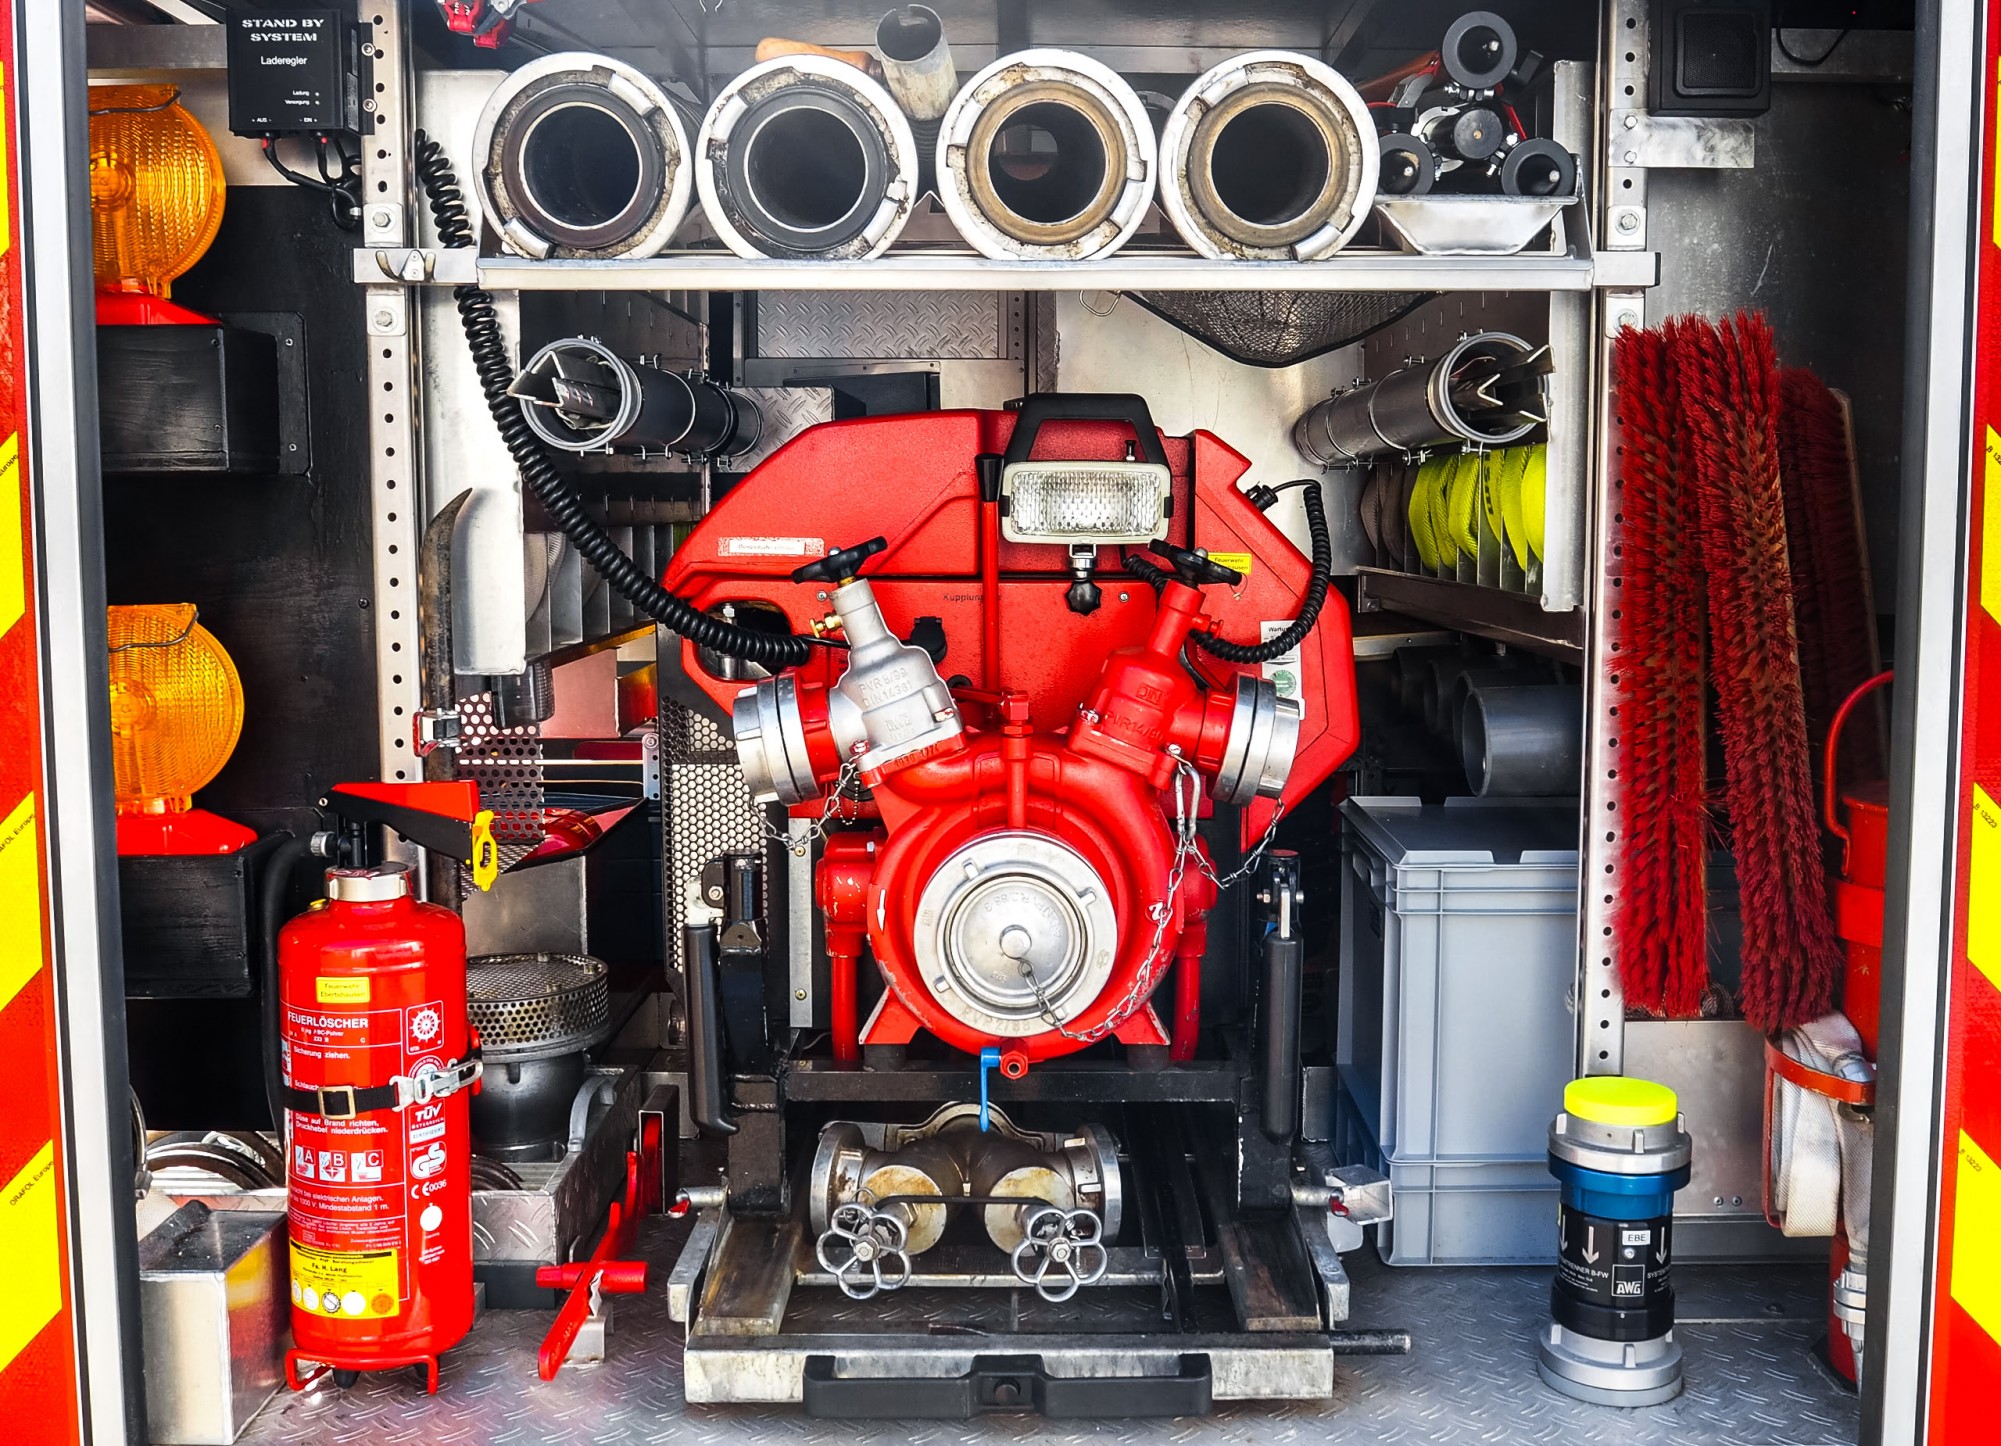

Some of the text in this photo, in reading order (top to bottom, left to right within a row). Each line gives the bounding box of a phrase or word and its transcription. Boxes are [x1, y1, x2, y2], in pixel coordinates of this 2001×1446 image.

[241, 19, 324, 28] STAND BY
[250, 33, 317, 42] SYSTEM
[260, 56, 307, 67] Laderegler
[287, 1011, 369, 1029] FEUERLÖSCHER
[325, 1052, 351, 1060] ziehen.
[415, 1103, 443, 1122] TÜV
[295, 1121, 389, 1135] Druckhebel niederdrücken.
[324, 1119, 346, 1127] Brand
[304, 1149, 314, 1163] A
[333, 1153, 344, 1167] B
[367, 1153, 379, 1166] C
[9, 1182, 35, 1206] ORAFOL
[313, 1192, 350, 1203] elektrischen
[351, 1196, 384, 1204] Anlagen.
[319, 1202, 372, 1211] Mindestabstand
[1627, 1233, 1647, 1242] EBE
[330, 1266, 348, 1274] Lang
[1591, 1269, 1609, 1279] B-FW
[1616, 1281, 1642, 1295] AWG
